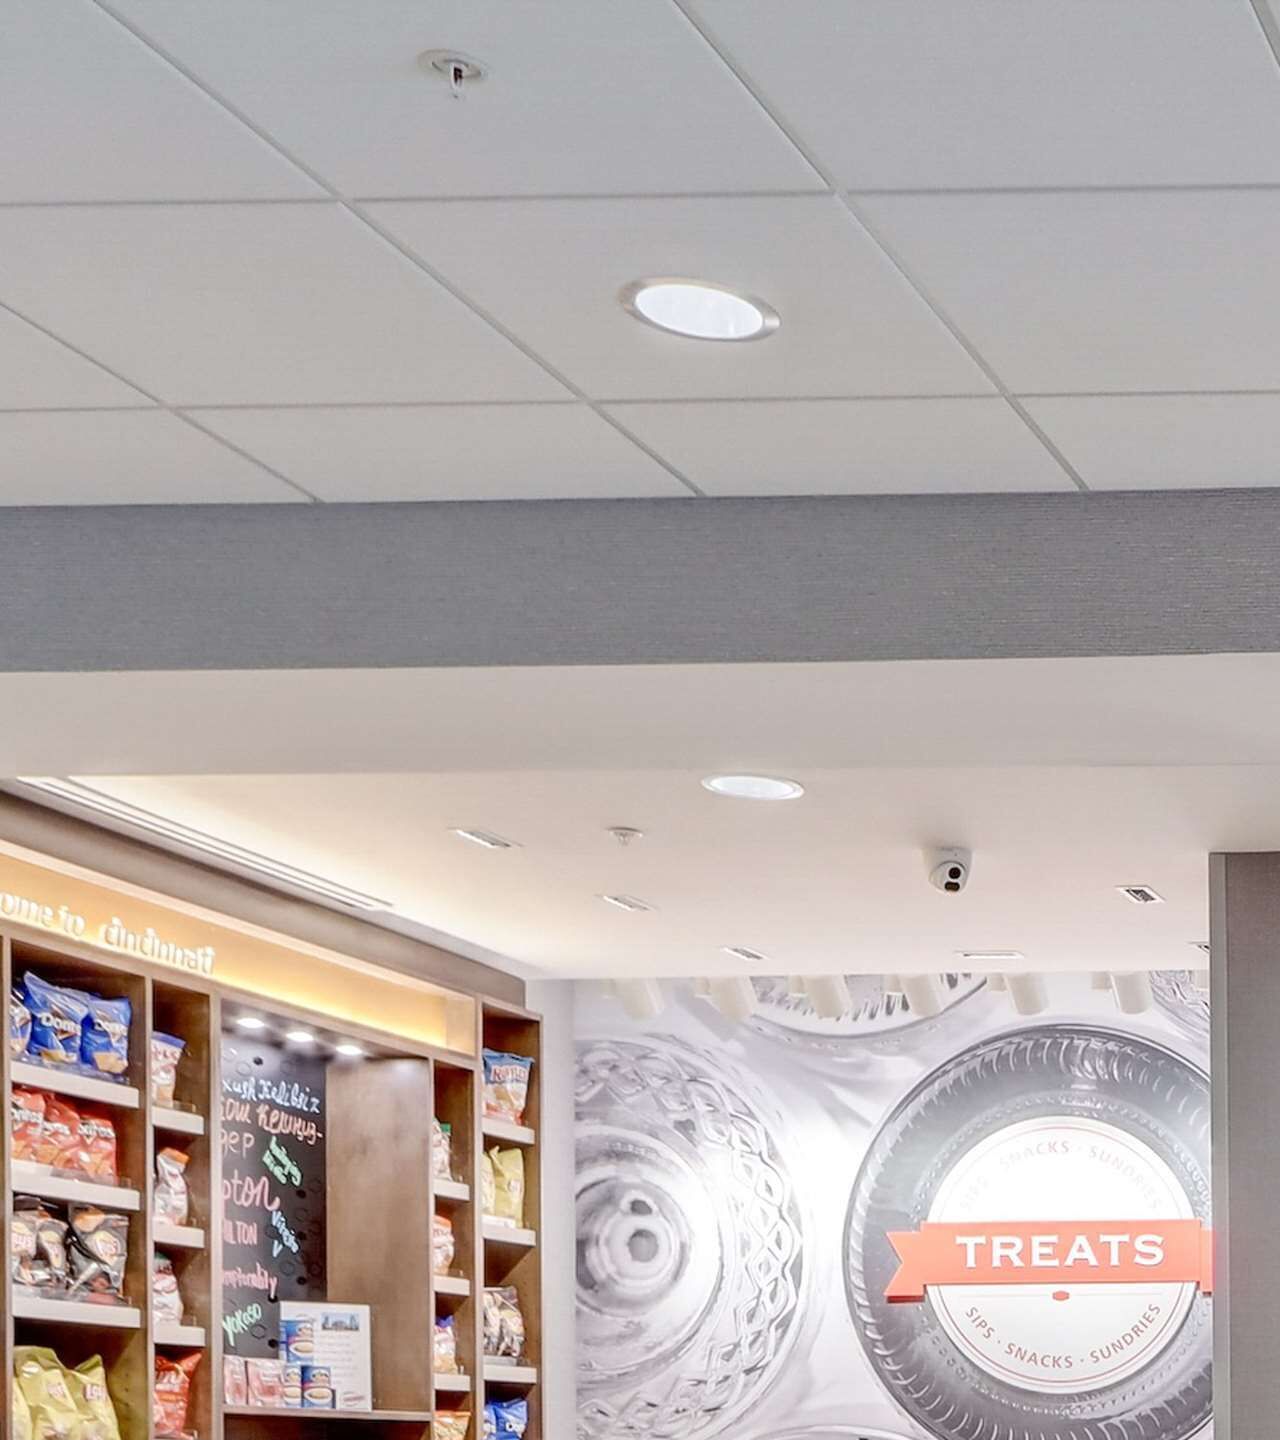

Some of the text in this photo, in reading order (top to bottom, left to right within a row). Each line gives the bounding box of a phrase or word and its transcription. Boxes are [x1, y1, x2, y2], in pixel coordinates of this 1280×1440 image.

[955, 1234, 1165, 1268] TREATS
[965, 1303, 1162, 1369] SIPS SNACKS SUNDRIES
